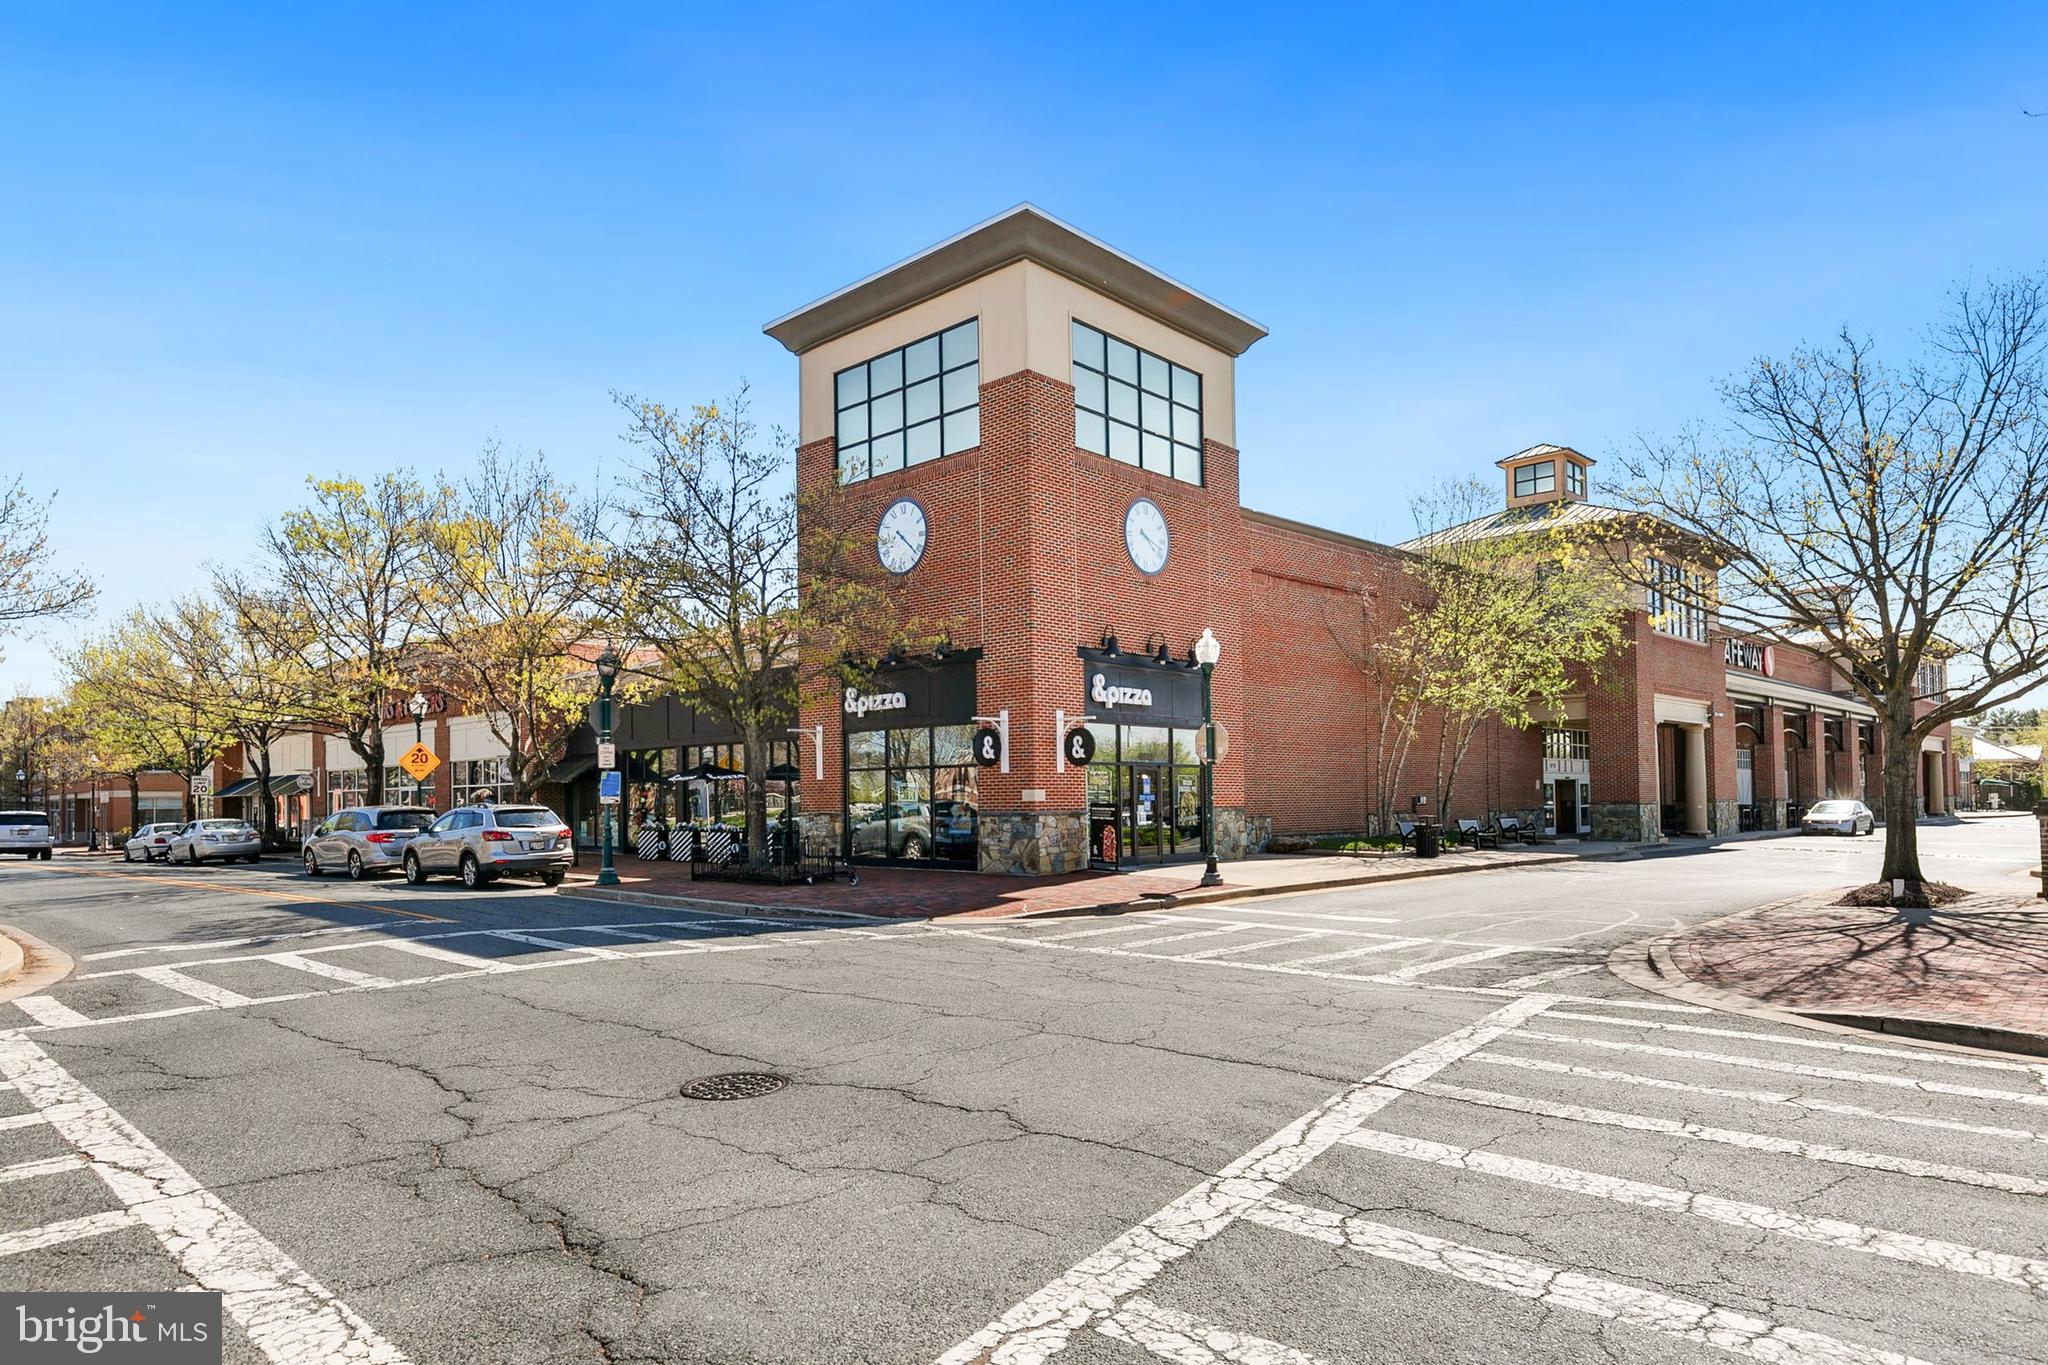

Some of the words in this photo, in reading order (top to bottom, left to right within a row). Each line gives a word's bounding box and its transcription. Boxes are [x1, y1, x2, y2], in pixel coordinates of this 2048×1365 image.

[1724, 638, 1762, 671] AFEWAY
[844, 687, 907, 718] &pizza
[1091, 673, 1153, 709] &pizza
[411, 753, 428, 764] 20
[982, 735, 995, 759] &
[1071, 735, 1086, 759] &
[193, 785, 208, 793] 20
